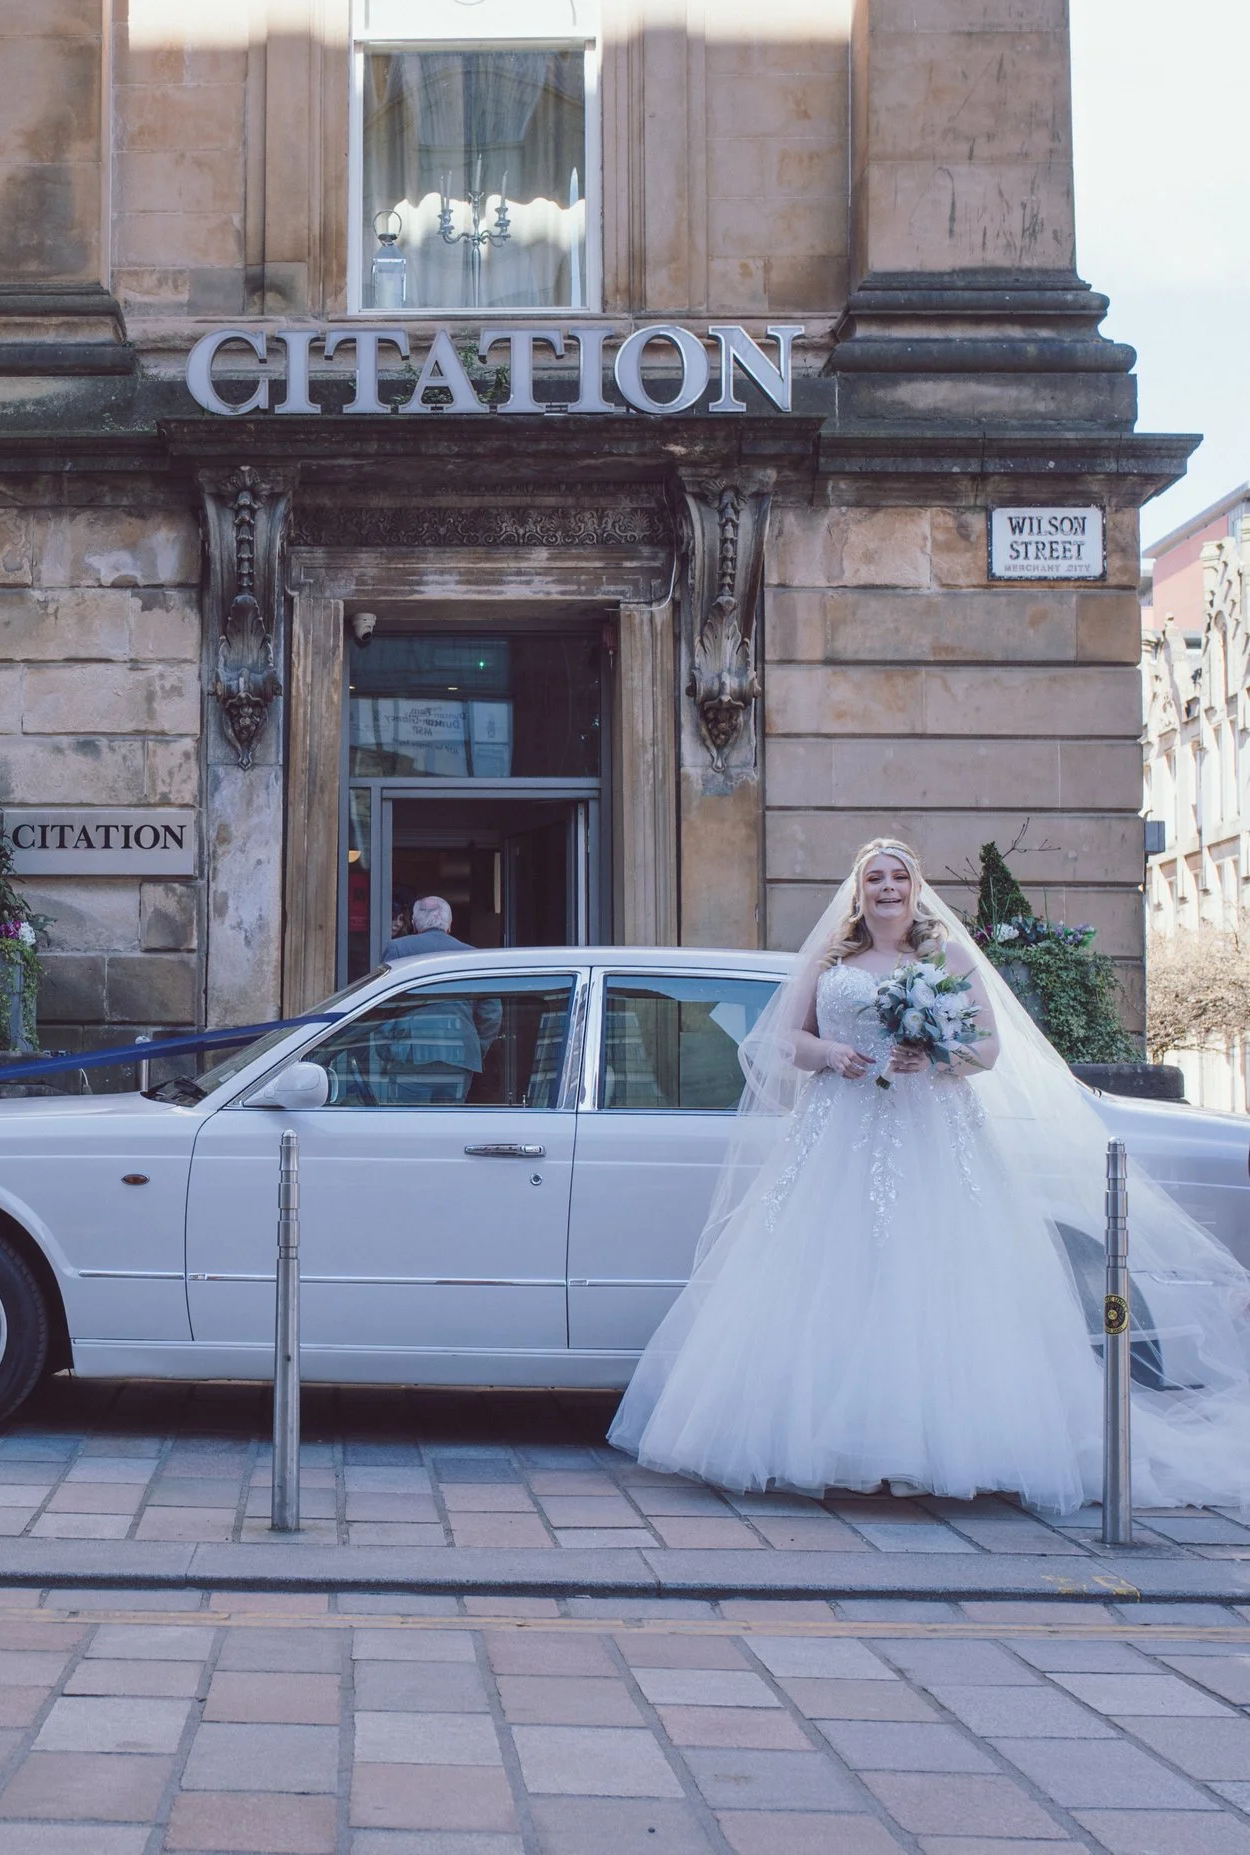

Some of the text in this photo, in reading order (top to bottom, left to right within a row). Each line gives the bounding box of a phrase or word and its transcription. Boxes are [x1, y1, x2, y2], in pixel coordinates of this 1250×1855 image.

[185, 325, 806, 415] CITATION
[1007, 516, 1087, 536] WILSON
[1009, 540, 1085, 561] STREET
[1004, 564, 1091, 573] MERCHANT CITY
[12, 824, 187, 850] CITATION
